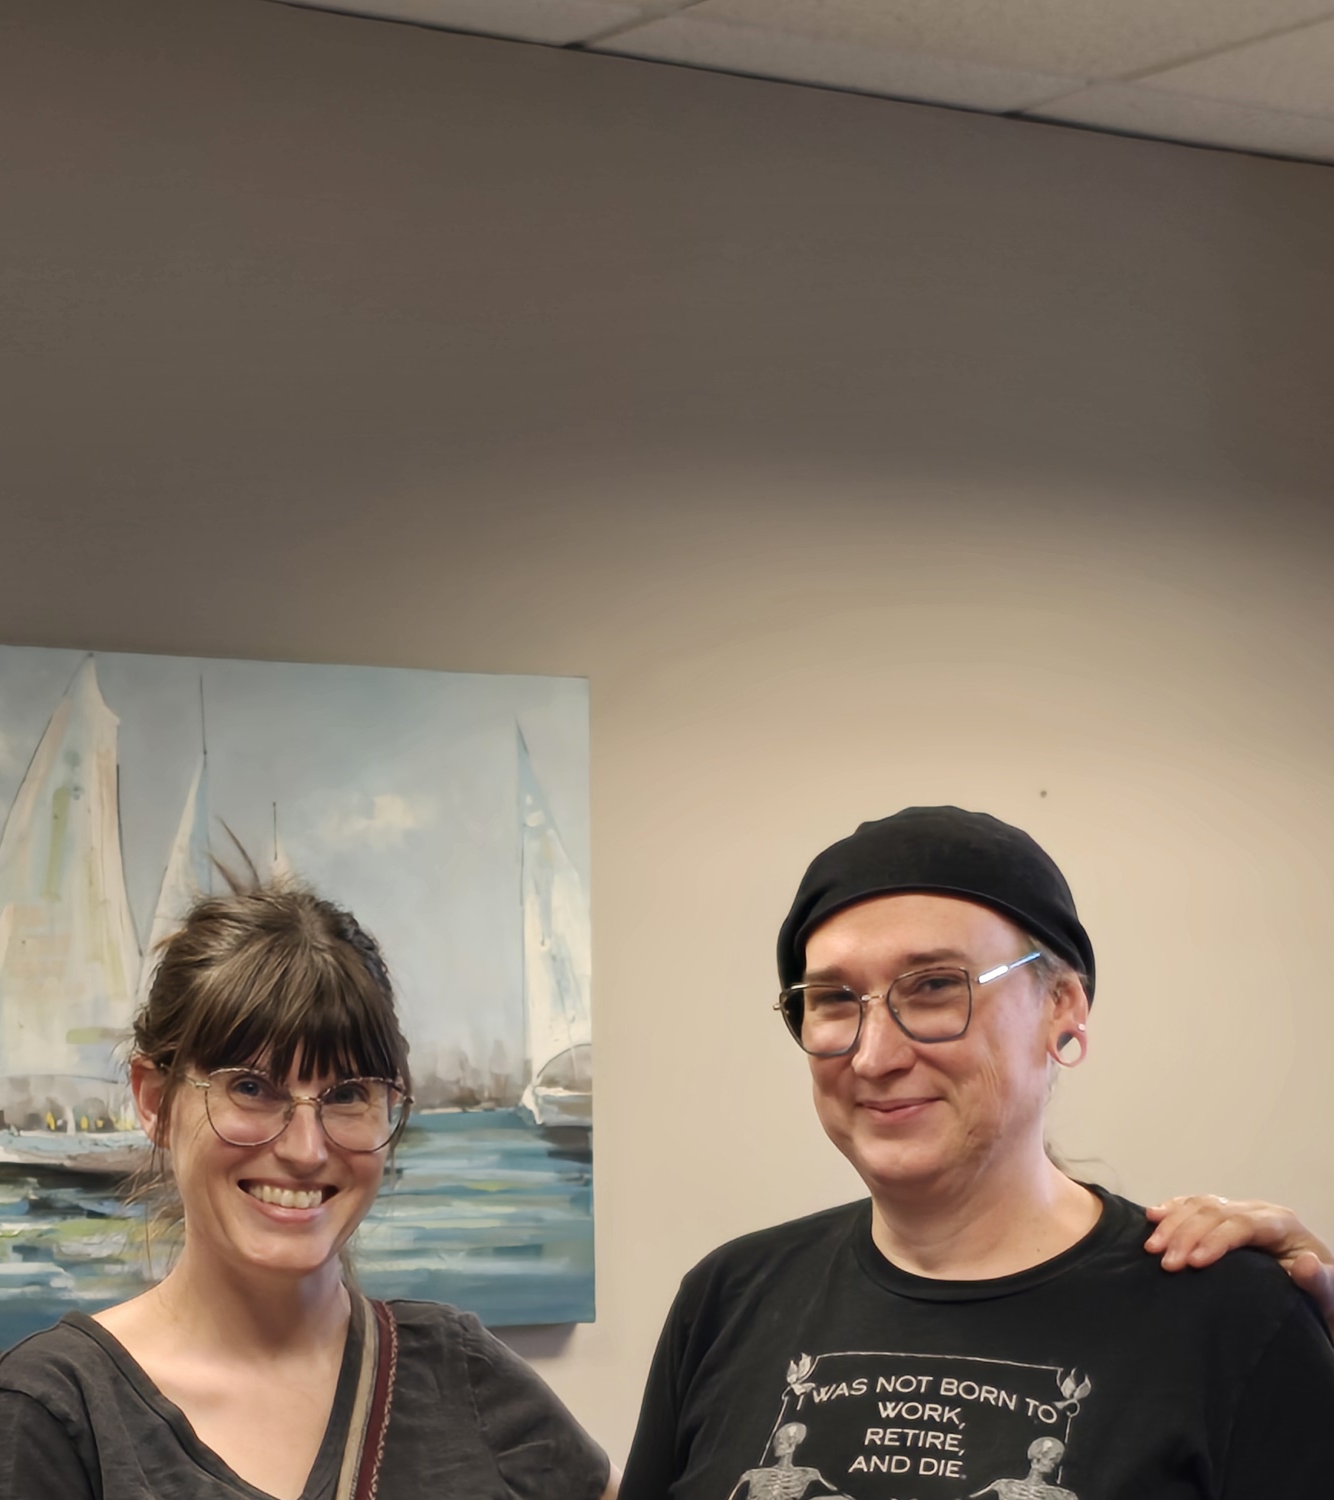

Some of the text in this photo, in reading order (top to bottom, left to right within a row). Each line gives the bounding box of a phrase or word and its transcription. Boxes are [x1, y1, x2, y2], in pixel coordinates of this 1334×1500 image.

[796, 1375, 1058, 1424] I WAS NOT BORN TO
[877, 1401, 966, 1430] WORK,
[864, 1427, 966, 1457] RETIRE,
[848, 1455, 911, 1474] AND
